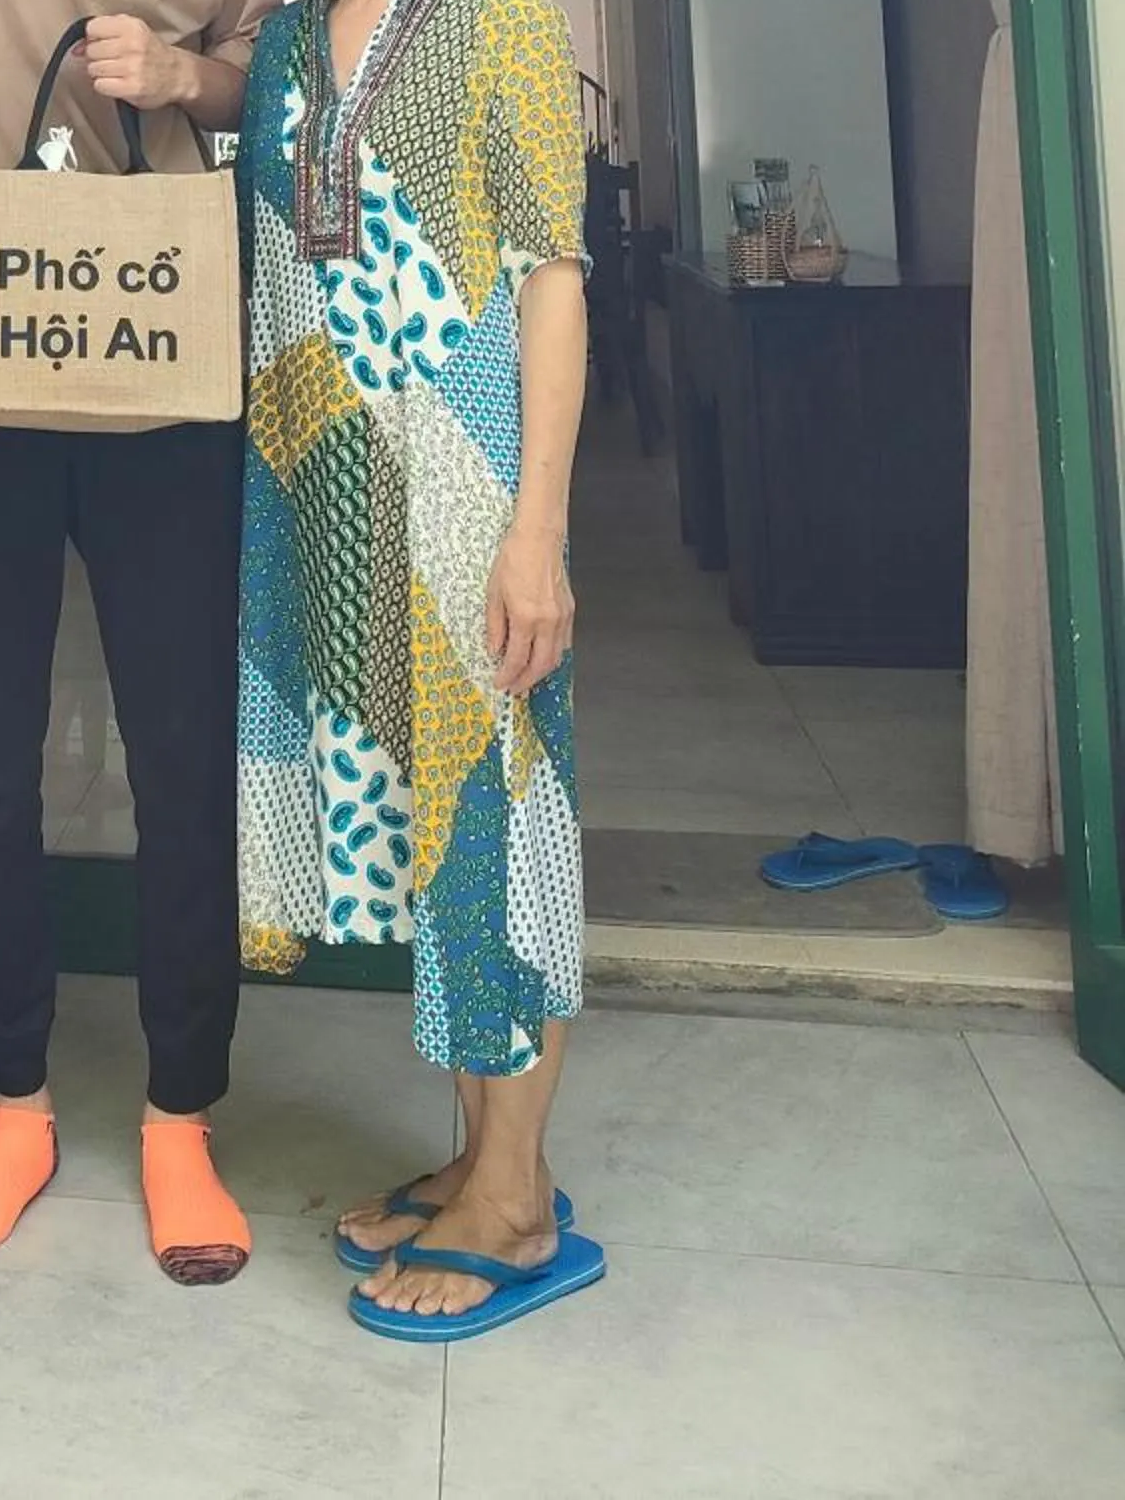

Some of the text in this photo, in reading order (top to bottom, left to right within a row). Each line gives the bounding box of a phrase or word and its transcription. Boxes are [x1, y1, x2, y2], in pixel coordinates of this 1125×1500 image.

[116, 247, 182, 294] cổ
[0, 314, 178, 371] Hội An
